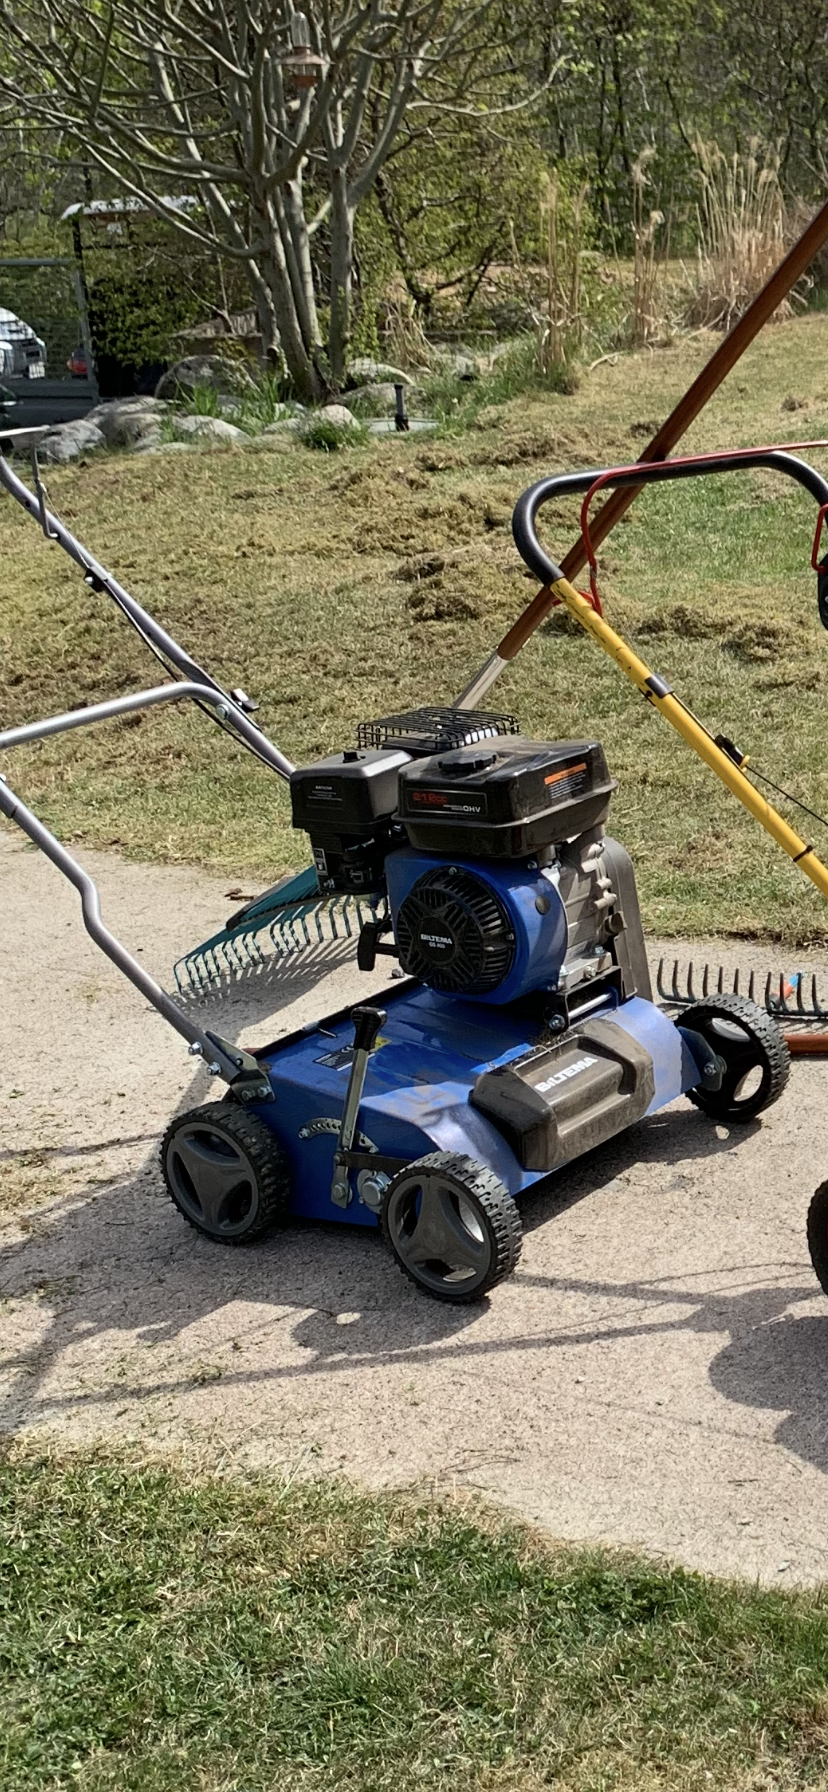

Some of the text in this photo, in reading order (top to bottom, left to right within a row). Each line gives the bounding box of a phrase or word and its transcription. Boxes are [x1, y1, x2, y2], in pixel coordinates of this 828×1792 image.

[463, 805, 481, 813] OHV
[420, 933, 453, 944] BILTEMA
[534, 1056, 599, 1093] BILTEMA
